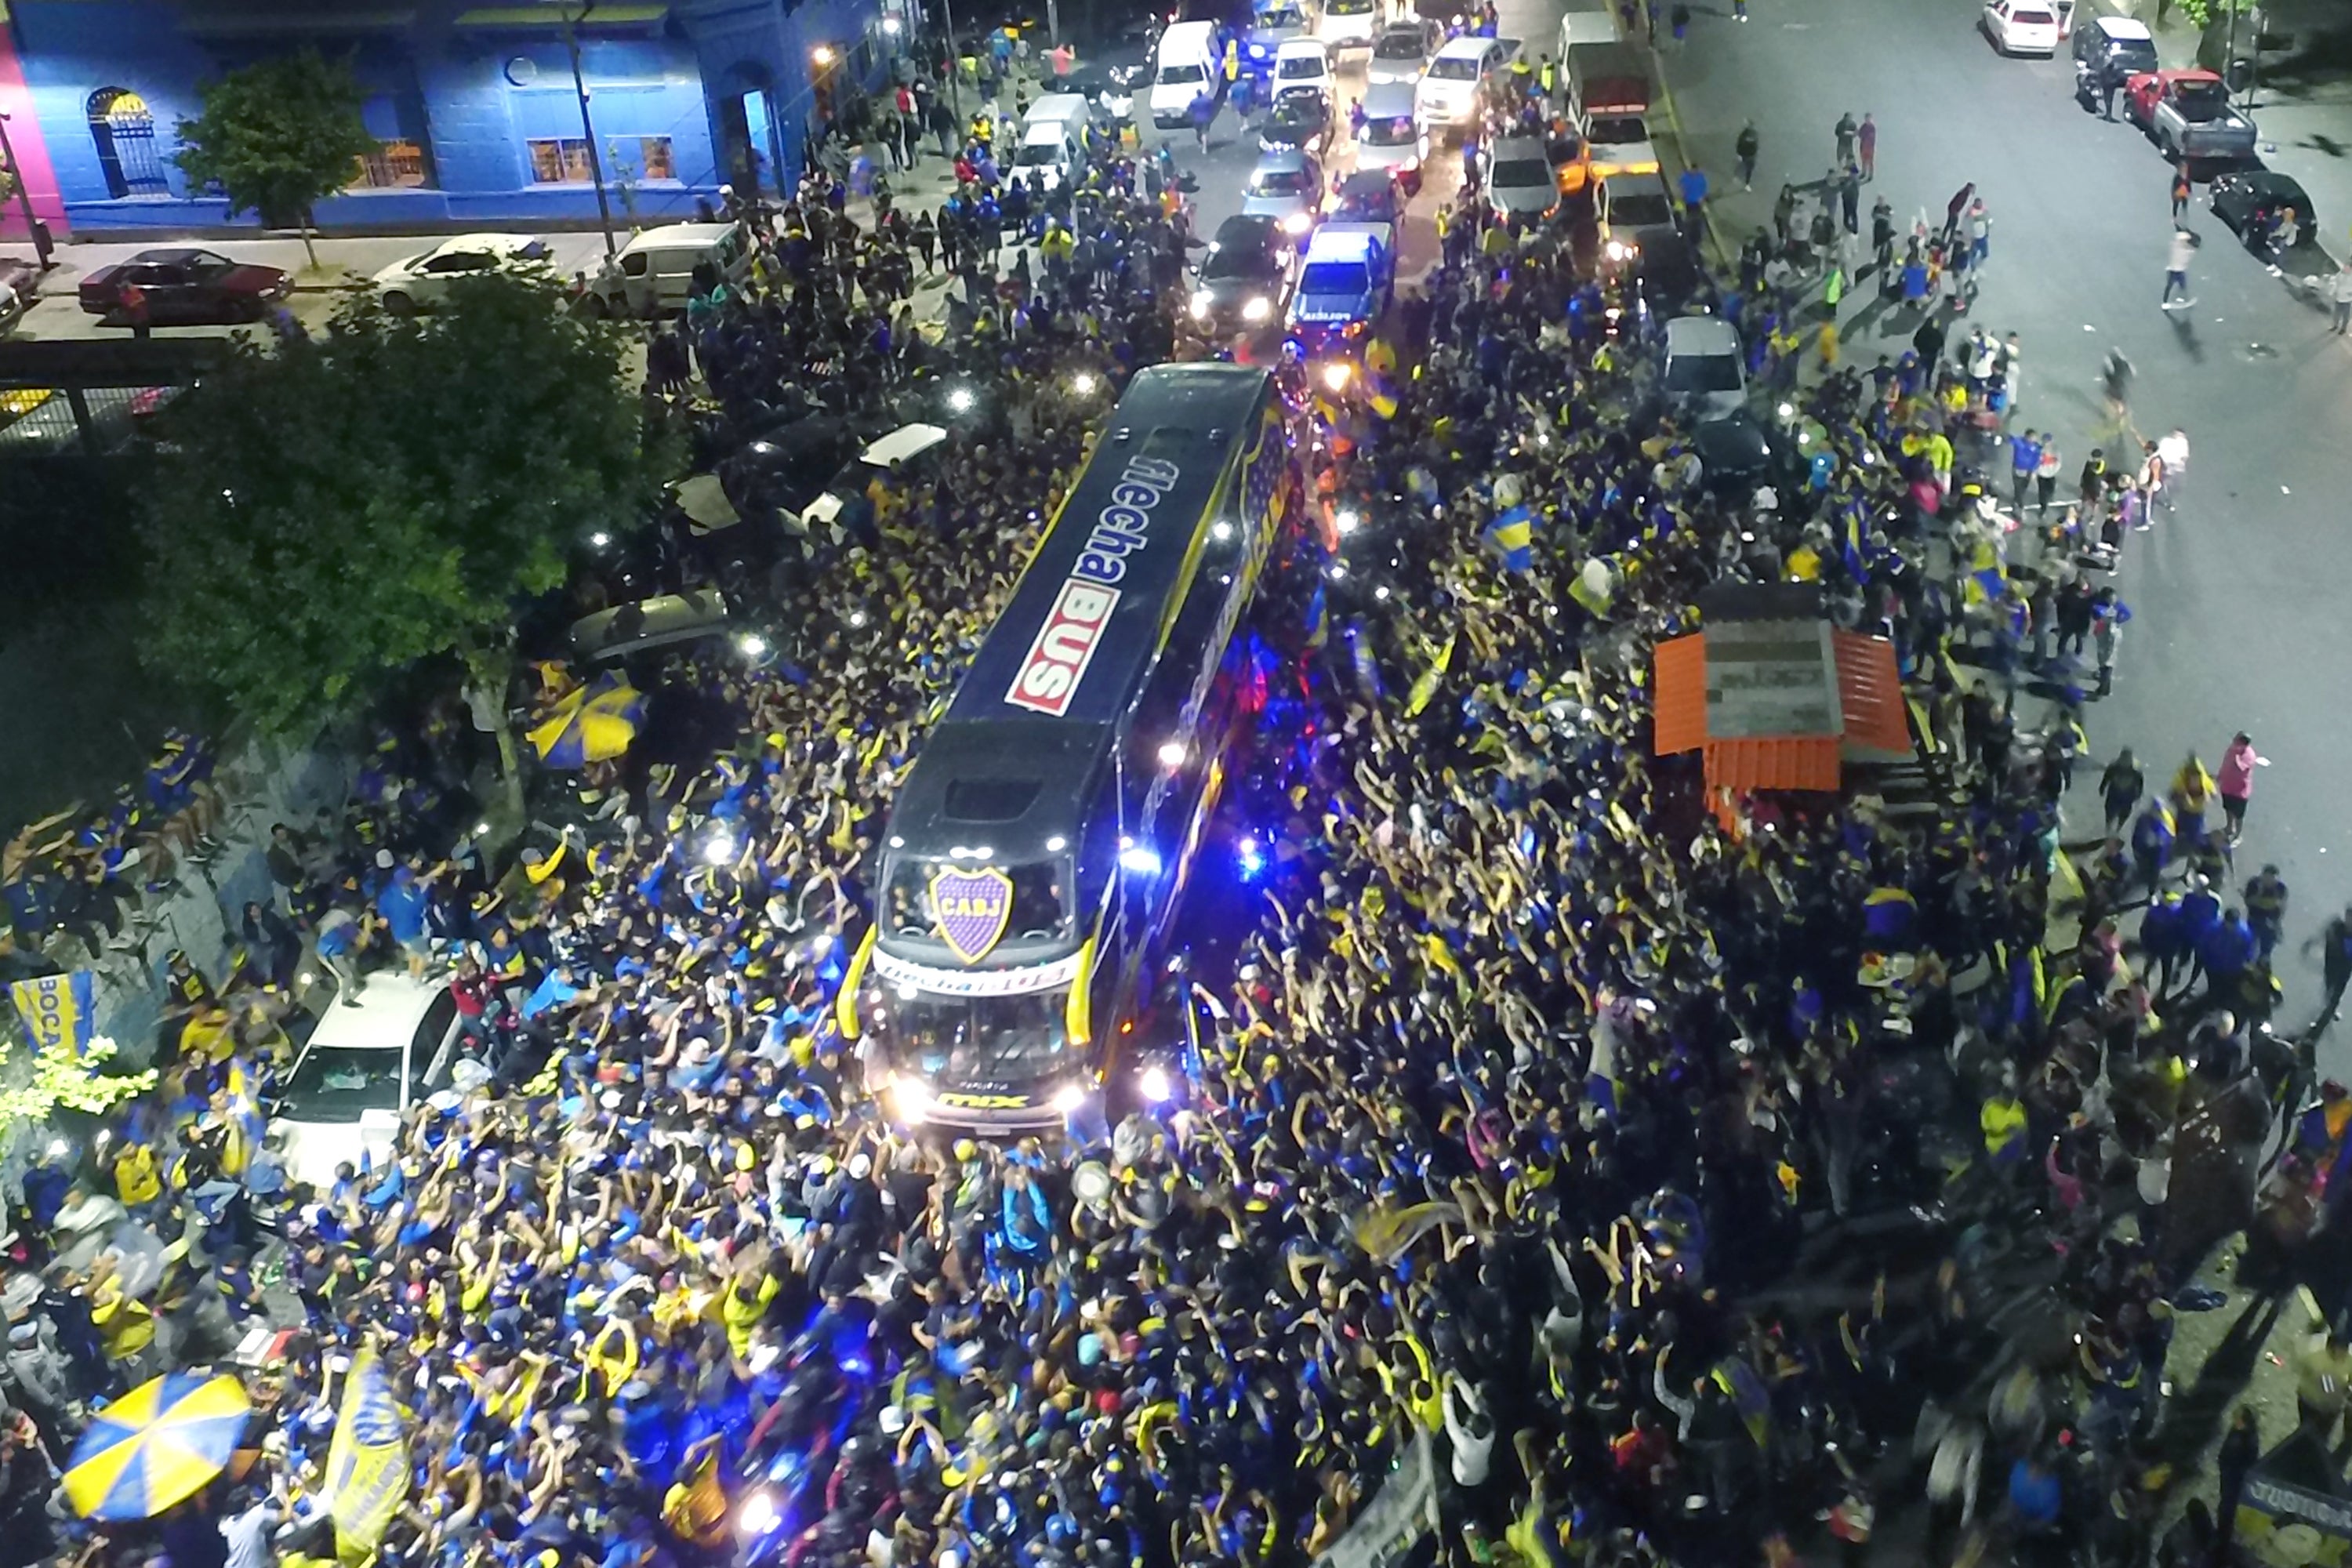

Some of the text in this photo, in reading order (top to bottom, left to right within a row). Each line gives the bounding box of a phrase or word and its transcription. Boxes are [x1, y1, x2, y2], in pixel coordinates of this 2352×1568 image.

[1022, 455, 1180, 700] flecha BUS
[941, 898, 1000, 918] CABJ
[38, 979, 61, 1047] BOCA
